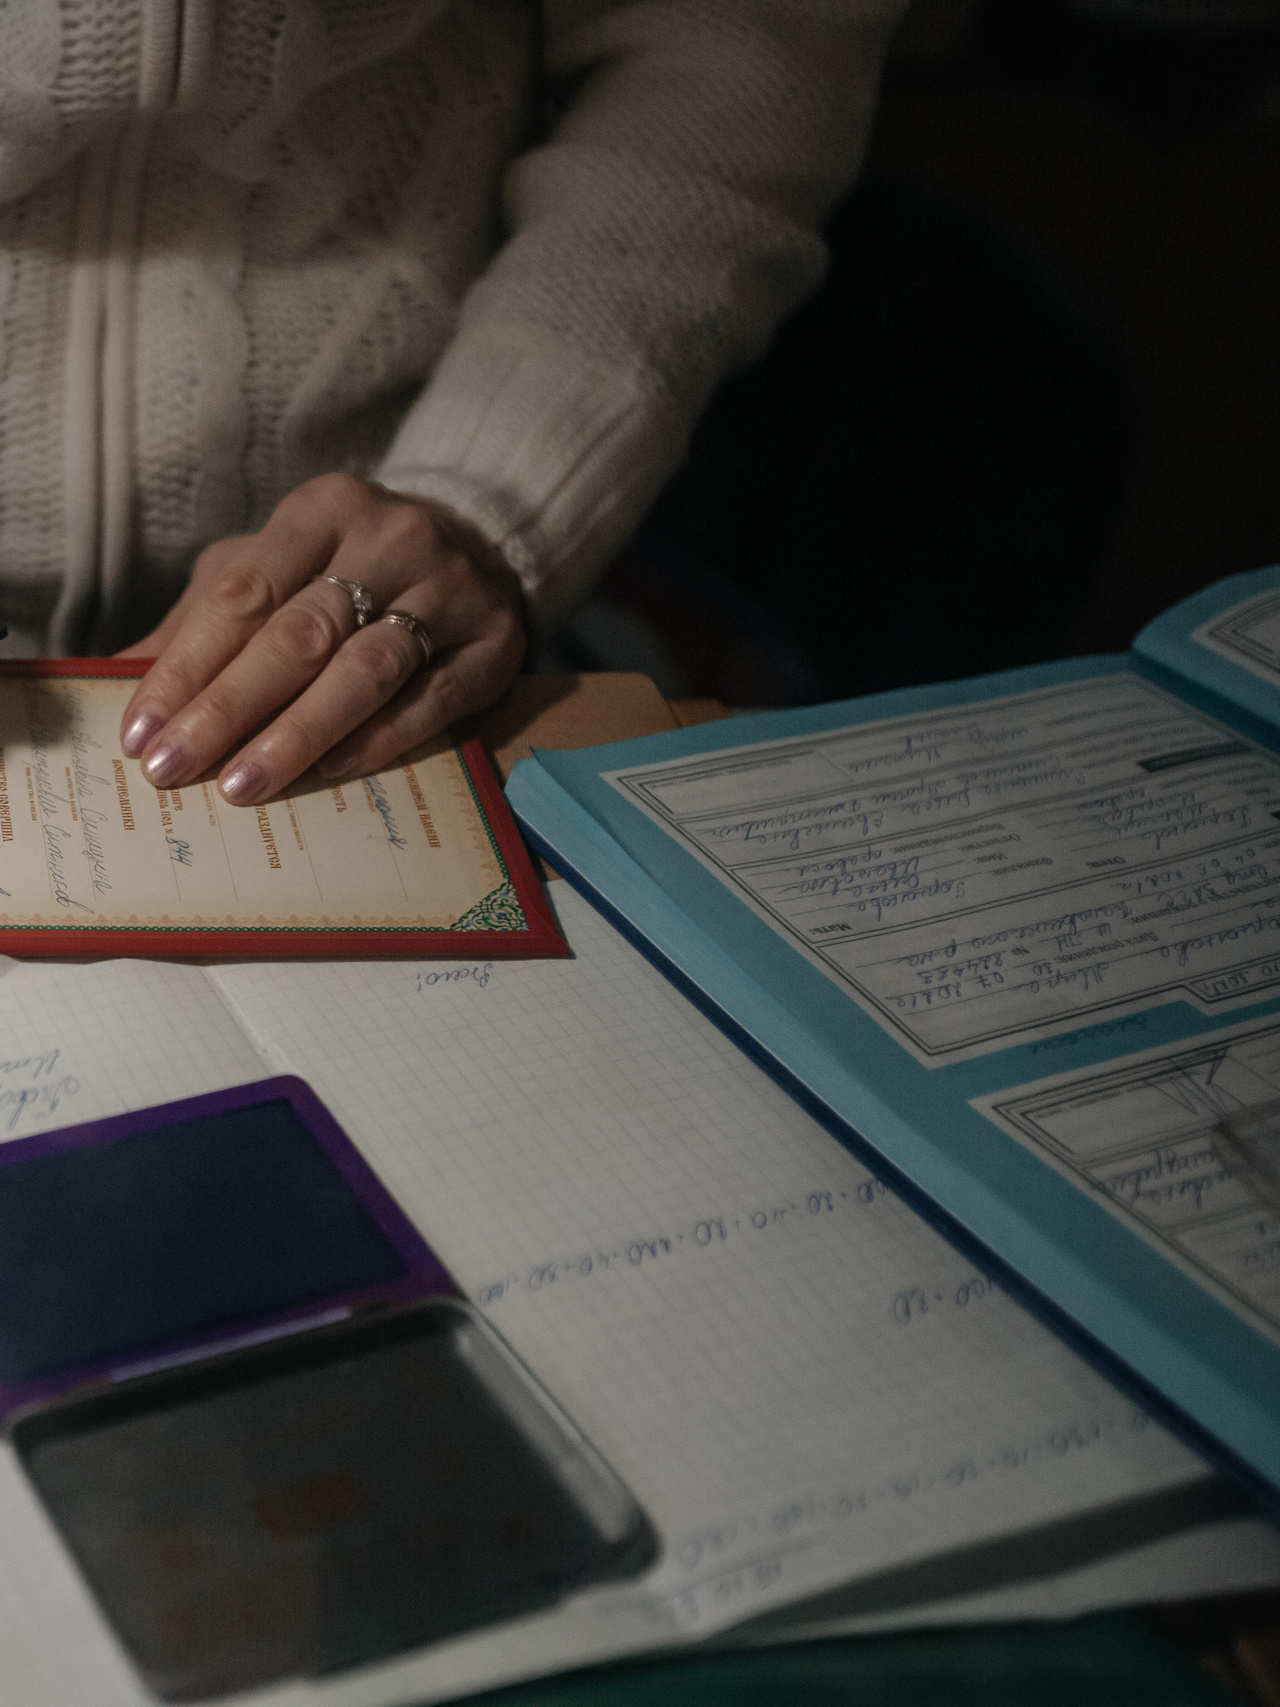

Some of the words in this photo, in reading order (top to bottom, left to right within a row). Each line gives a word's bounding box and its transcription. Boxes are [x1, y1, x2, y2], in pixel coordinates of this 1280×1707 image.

[112, 759, 135, 832] ВОСПРИЕМНИКИ
[170, 790, 184, 811] НИГЕ
[161, 811, 173, 826] ПОД
[404, 766, 428, 811] ЕЧЕНИЕМ
[419, 814, 441, 849] ИМЕНИ
[165, 837, 193, 867] 844
[808, 922, 852, 937] Мать:
[1123, 930, 1160, 948] Дата
[1055, 938, 1124, 964] рождения:
